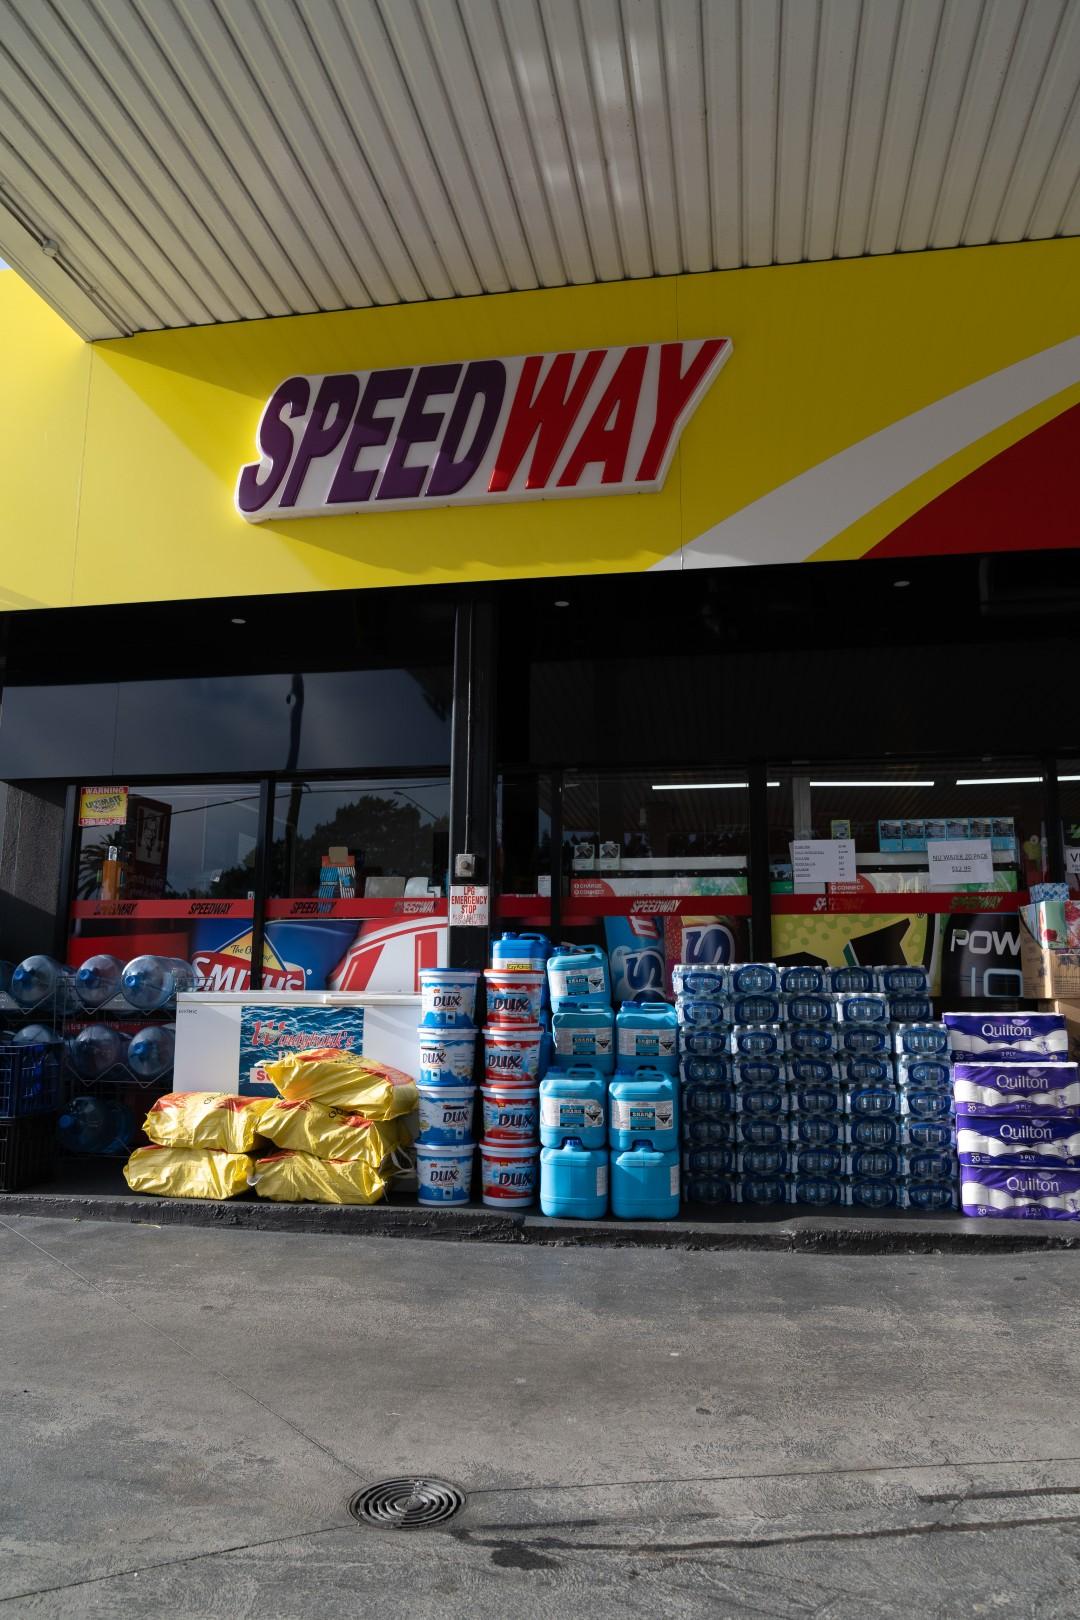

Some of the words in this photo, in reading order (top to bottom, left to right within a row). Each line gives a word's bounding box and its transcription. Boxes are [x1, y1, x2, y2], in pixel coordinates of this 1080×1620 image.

[238, 338, 728, 513] SPEEDWAY
[463, 886, 475, 895] LPG
[451, 895, 488, 904] EMERGENCY
[630, 899, 682, 913] SPEEDWAY
[188, 903, 233, 915] SPEEDWAY
[290, 902, 337, 914] SPEEDWAY
[461, 905, 477, 914] STOP
[950, 928, 1021, 956] POW
[192, 956, 302, 992] SMIH'S
[433, 996, 461, 1007] DUX
[493, 998, 529, 1011] DUX
[981, 1023, 1032, 1039] Quilton
[422, 1052, 446, 1064] DUX
[488, 1055, 524, 1069] DUX
[996, 1074, 1049, 1090] Quilton
[443, 1110, 469, 1123] DUX
[498, 1113, 533, 1127] DUX
[999, 1124, 1052, 1140] Quilton
[971, 1155, 980, 1163] 20
[430, 1169, 459, 1182] DUX
[498, 1172, 533, 1186] DUX
[1006, 1176, 1060, 1192] Quilton
[977, 1207, 986, 1215] 20
